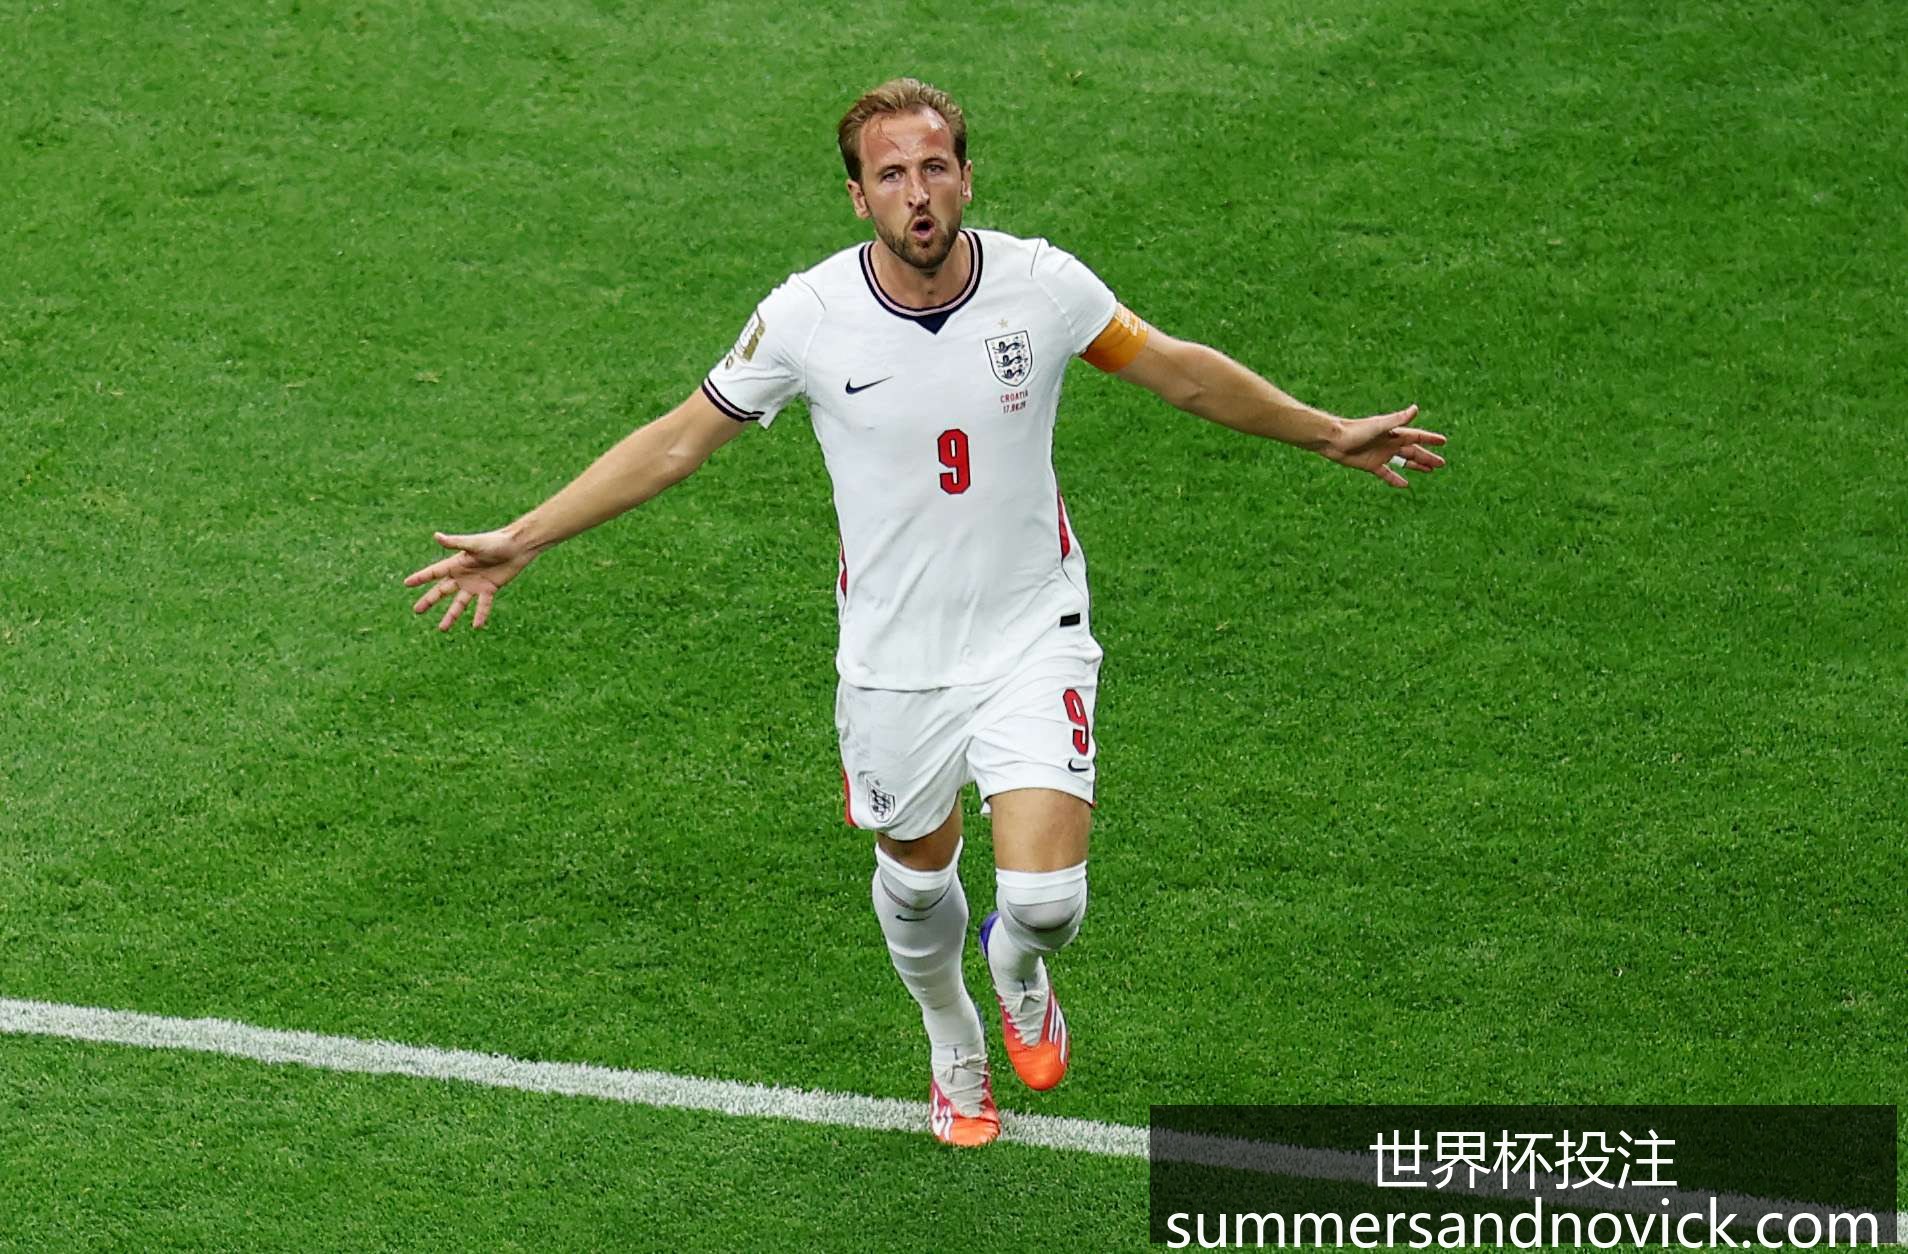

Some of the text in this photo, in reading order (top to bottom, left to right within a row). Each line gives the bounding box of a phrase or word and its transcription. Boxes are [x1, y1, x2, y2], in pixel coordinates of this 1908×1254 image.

[1000, 389, 1028, 403] CROATIA
[937, 428, 971, 495] 9
[1063, 688, 1089, 756] 9
